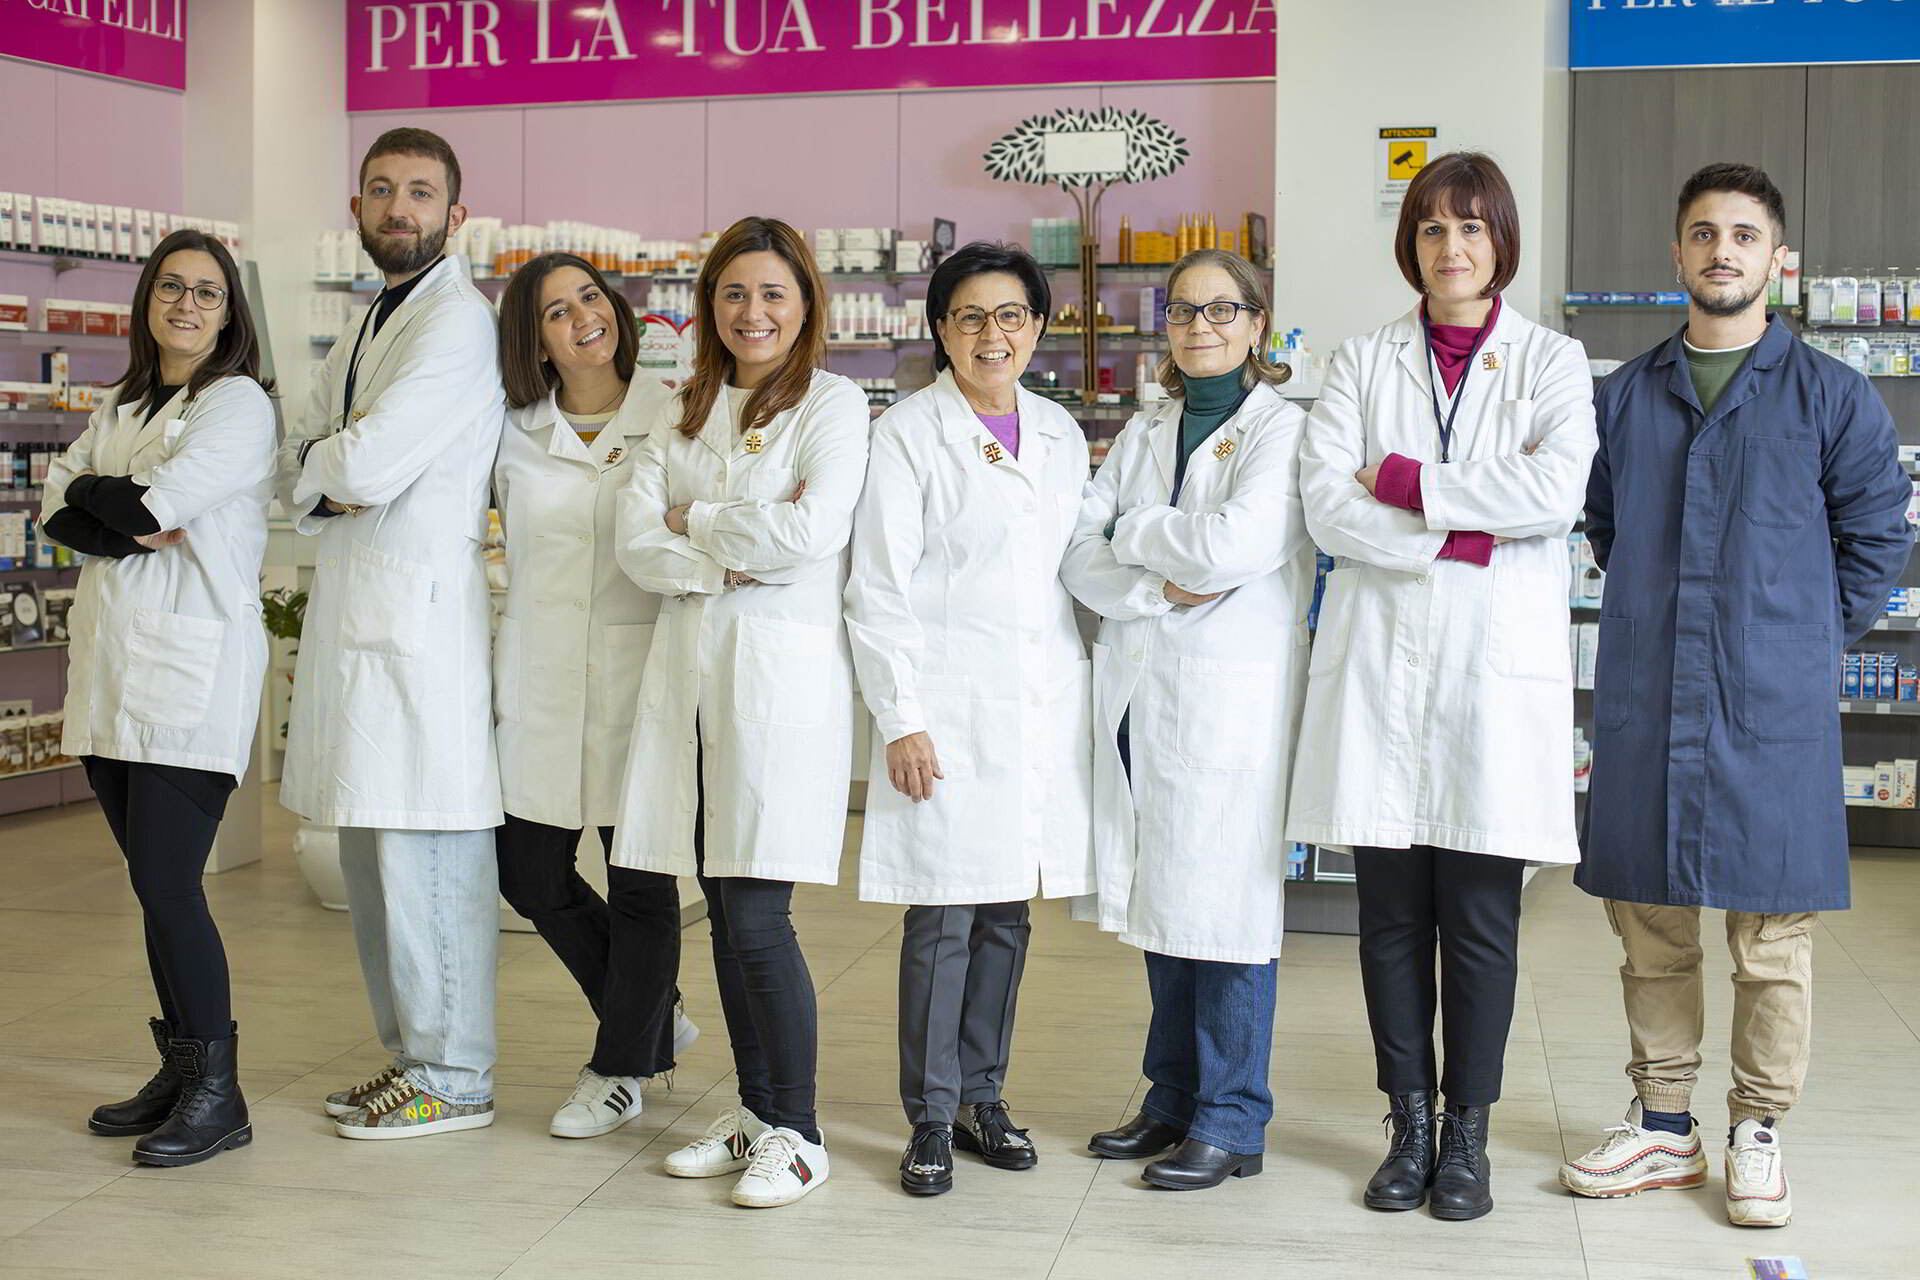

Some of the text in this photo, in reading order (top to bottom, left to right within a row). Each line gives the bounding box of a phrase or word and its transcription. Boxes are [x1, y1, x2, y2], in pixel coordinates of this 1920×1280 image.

[364, 0, 508, 72] PER
[530, 0, 639, 64] LA
[662, 0, 827, 58] TUA
[406, 1102, 442, 1119] NOT
